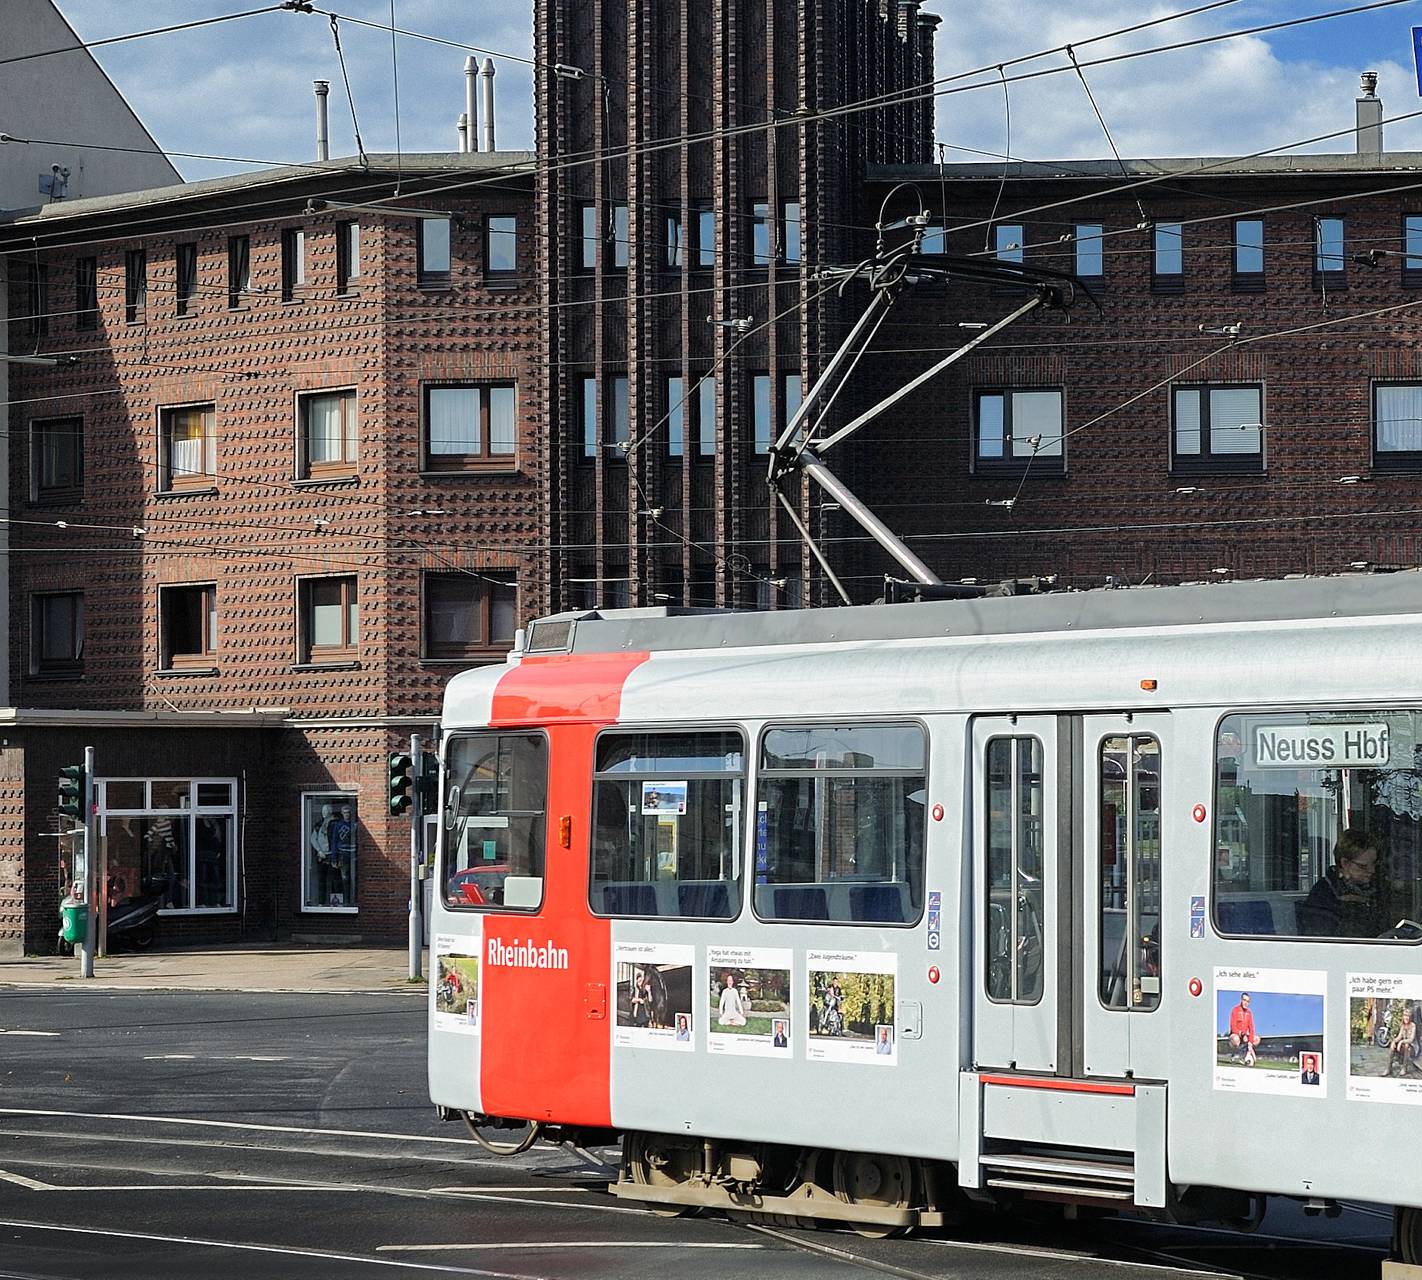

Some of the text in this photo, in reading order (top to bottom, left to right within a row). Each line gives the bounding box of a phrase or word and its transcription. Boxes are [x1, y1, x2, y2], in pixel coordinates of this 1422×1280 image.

[1259, 730, 1389, 762] Neuss Hbf
[488, 937, 569, 970] Rheinbahn
